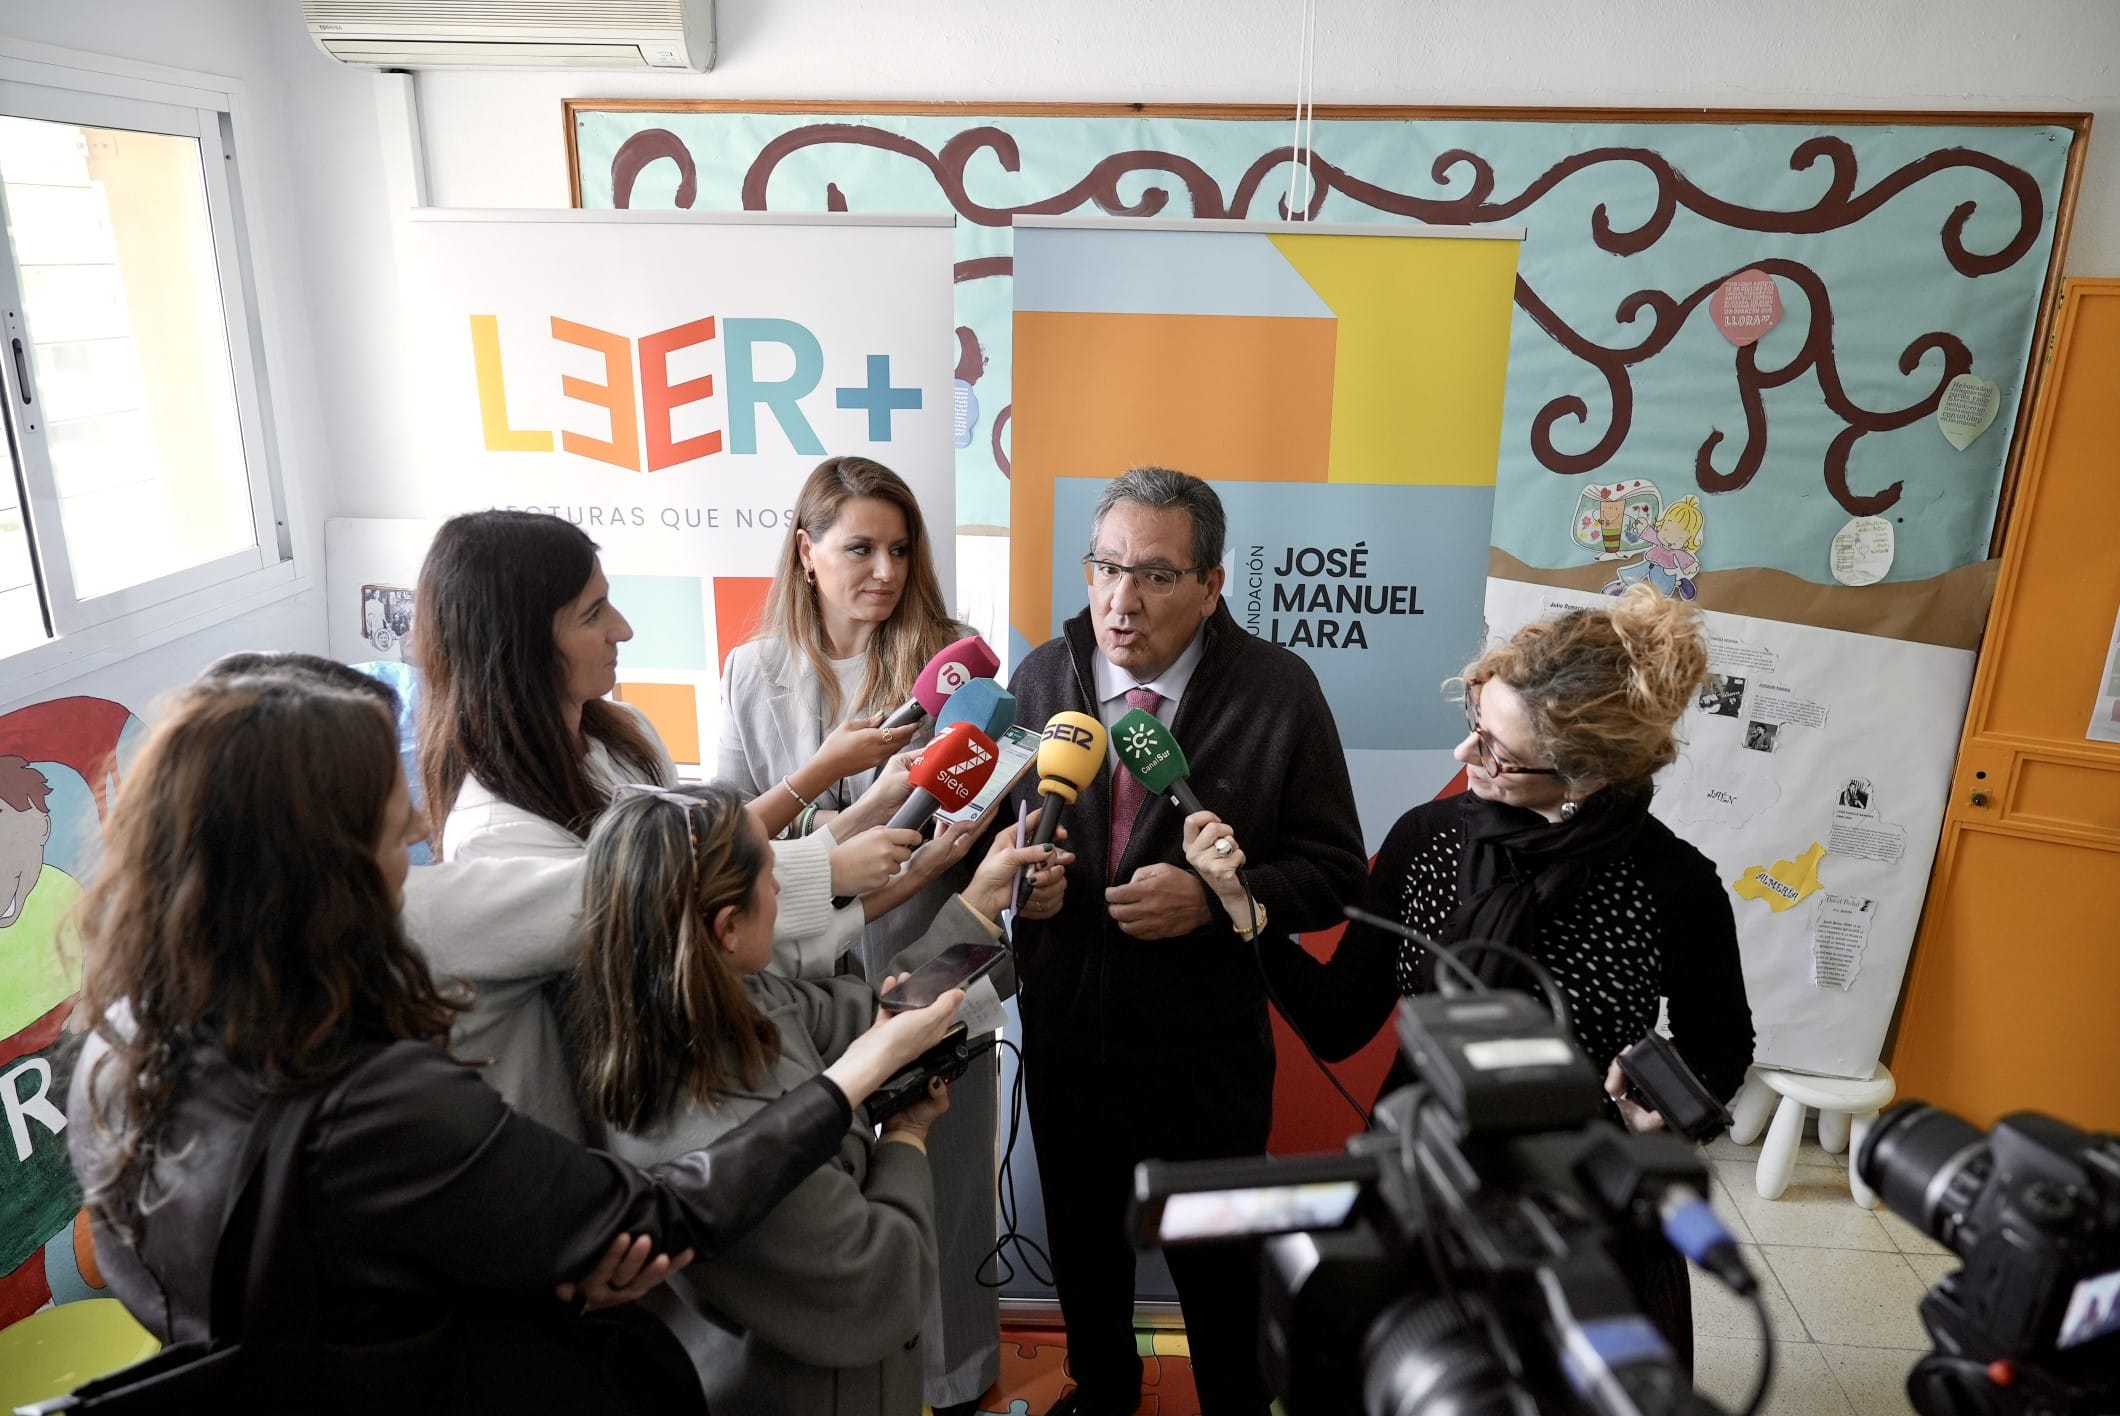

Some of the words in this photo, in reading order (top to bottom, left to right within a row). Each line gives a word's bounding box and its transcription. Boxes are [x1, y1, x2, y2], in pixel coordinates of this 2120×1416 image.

[661, 507, 720, 531] QUE
[1273, 540, 1369, 579] JOSÉ
[1246, 545, 1265, 636] UNDACIÓN
[1272, 582, 1425, 616] MANUEL
[1271, 618, 1369, 650] LARA
[1042, 723, 1094, 751] SER
[937, 769, 970, 799] siete
